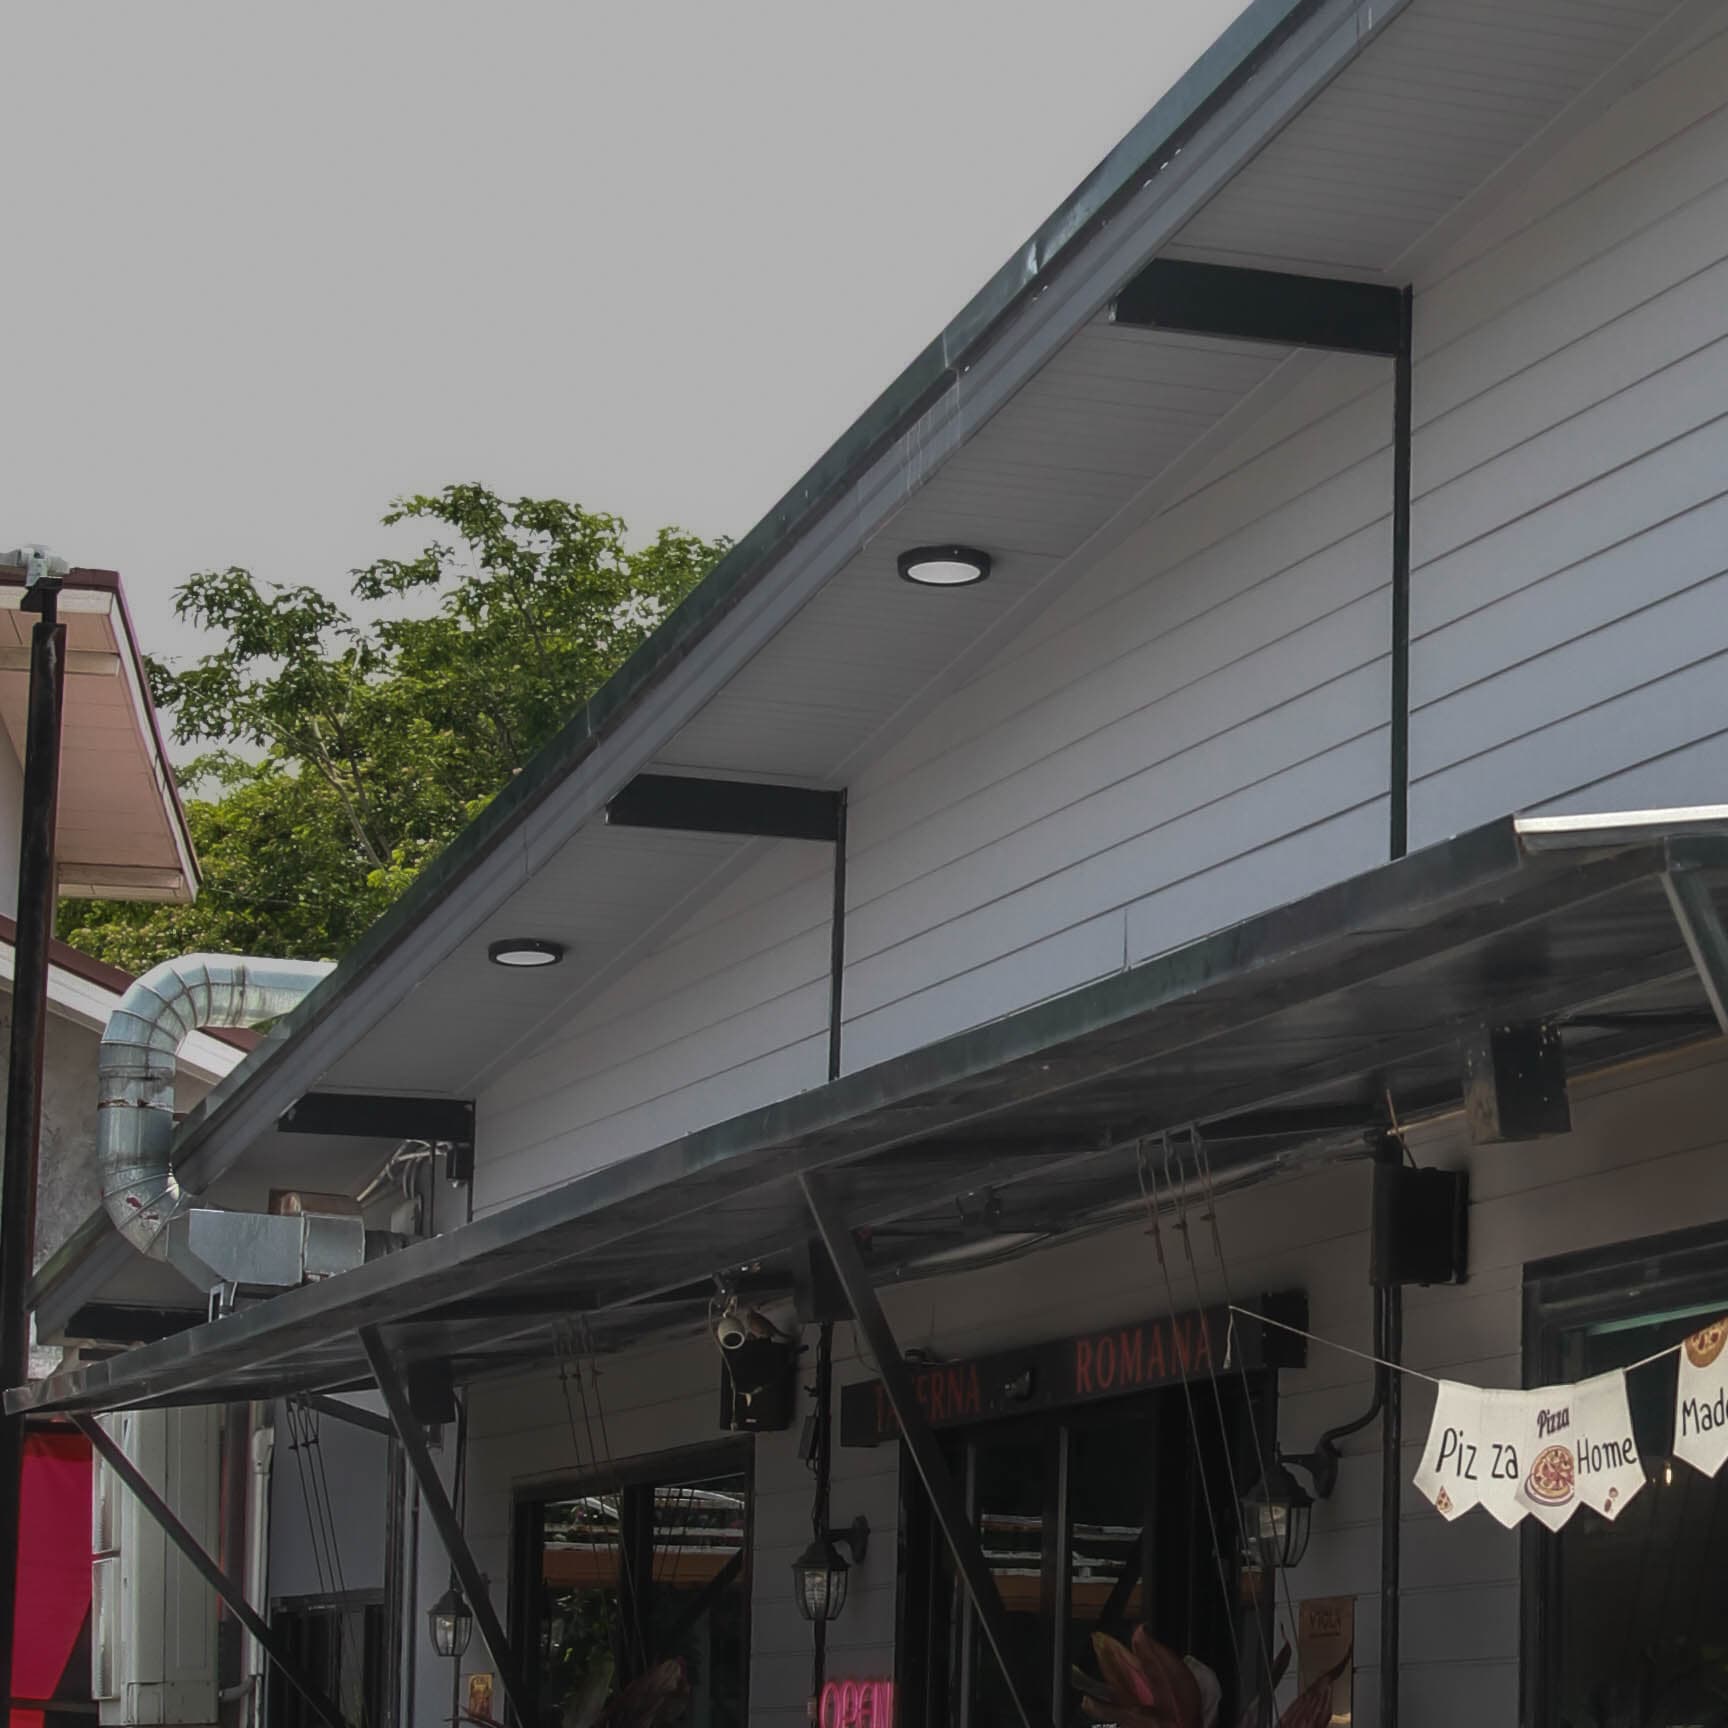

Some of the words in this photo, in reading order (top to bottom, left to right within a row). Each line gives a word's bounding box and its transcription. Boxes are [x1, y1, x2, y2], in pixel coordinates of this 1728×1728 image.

[1074, 1313, 1213, 1394] ROMANA
[1536, 1406, 1571, 1439] Pizza
[1576, 1433, 1638, 1475] Home
